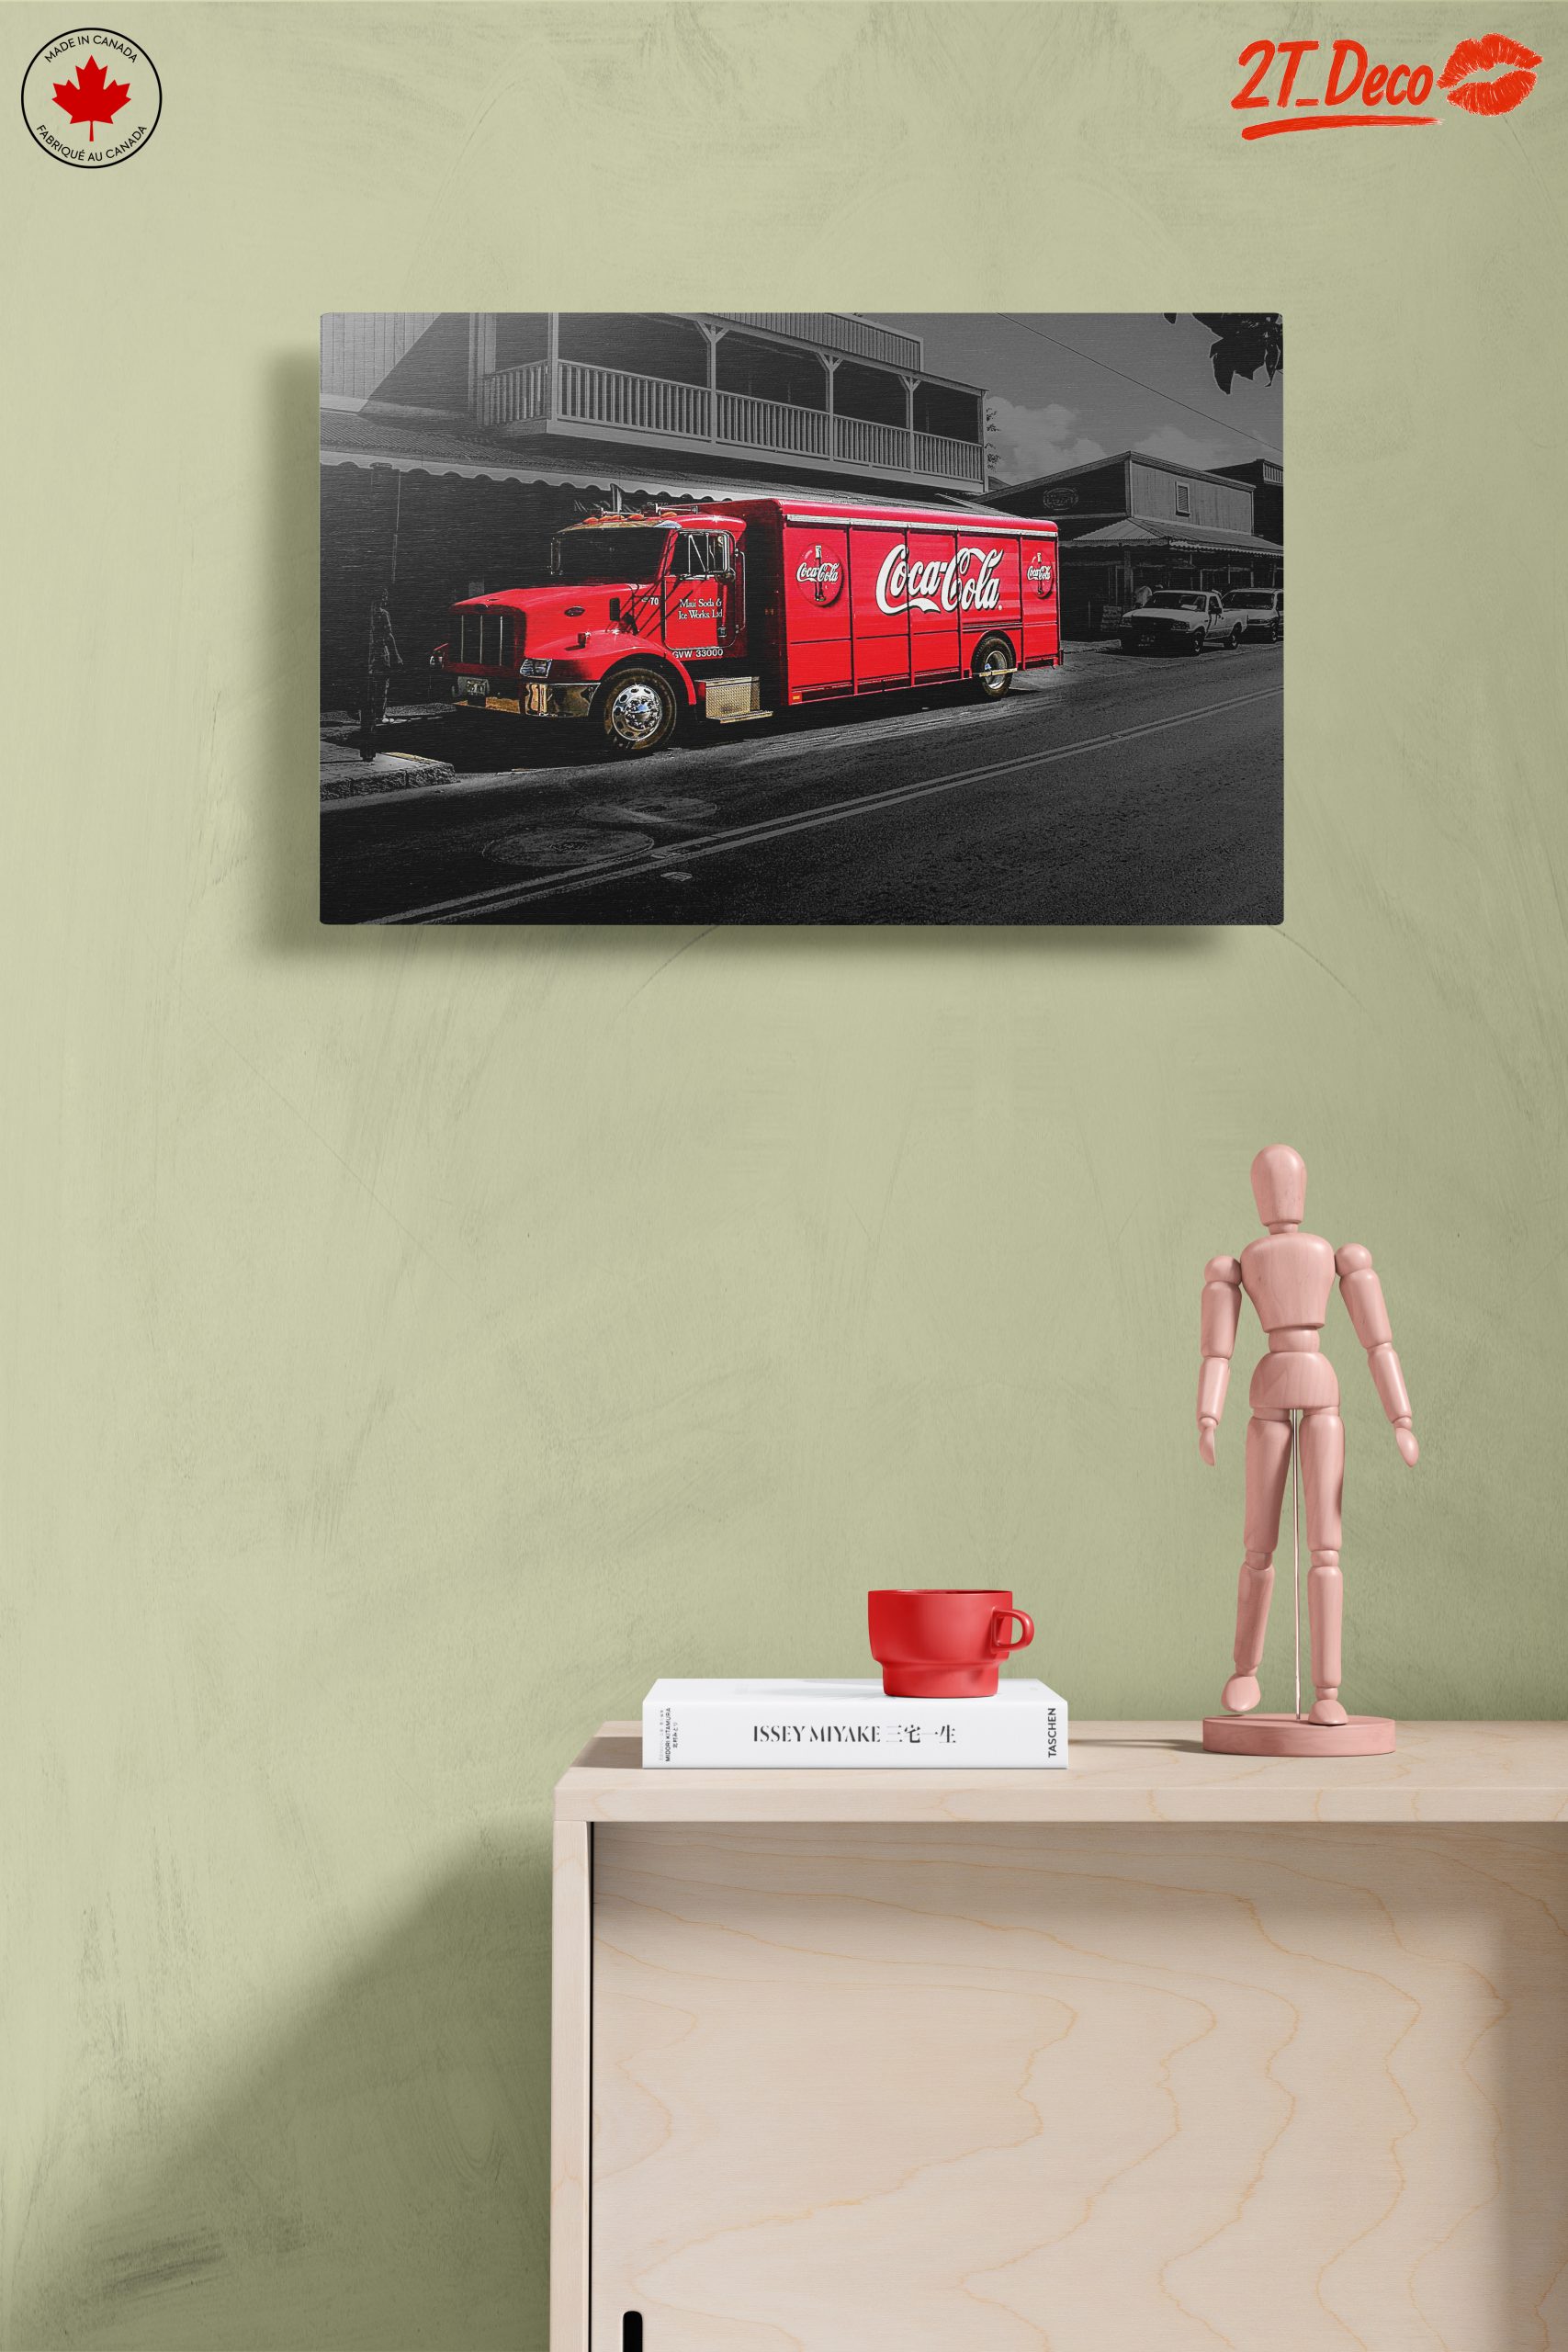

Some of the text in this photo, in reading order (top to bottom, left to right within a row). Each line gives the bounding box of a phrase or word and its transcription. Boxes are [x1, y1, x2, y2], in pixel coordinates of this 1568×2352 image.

[796, 561, 840, 582] Coca-Cola
[875, 543, 1004, 614] Coca-Cola
[650, 597, 660, 605] 70
[680, 599, 696, 608] Maui
[698, 598, 715, 607] Soda
[672, 649, 724, 659] GVW 33000
[753, 1724, 956, 1743] ISSEY MIYAKE 三宅一生
[1047, 1707, 1057, 1758] TASCHEN
